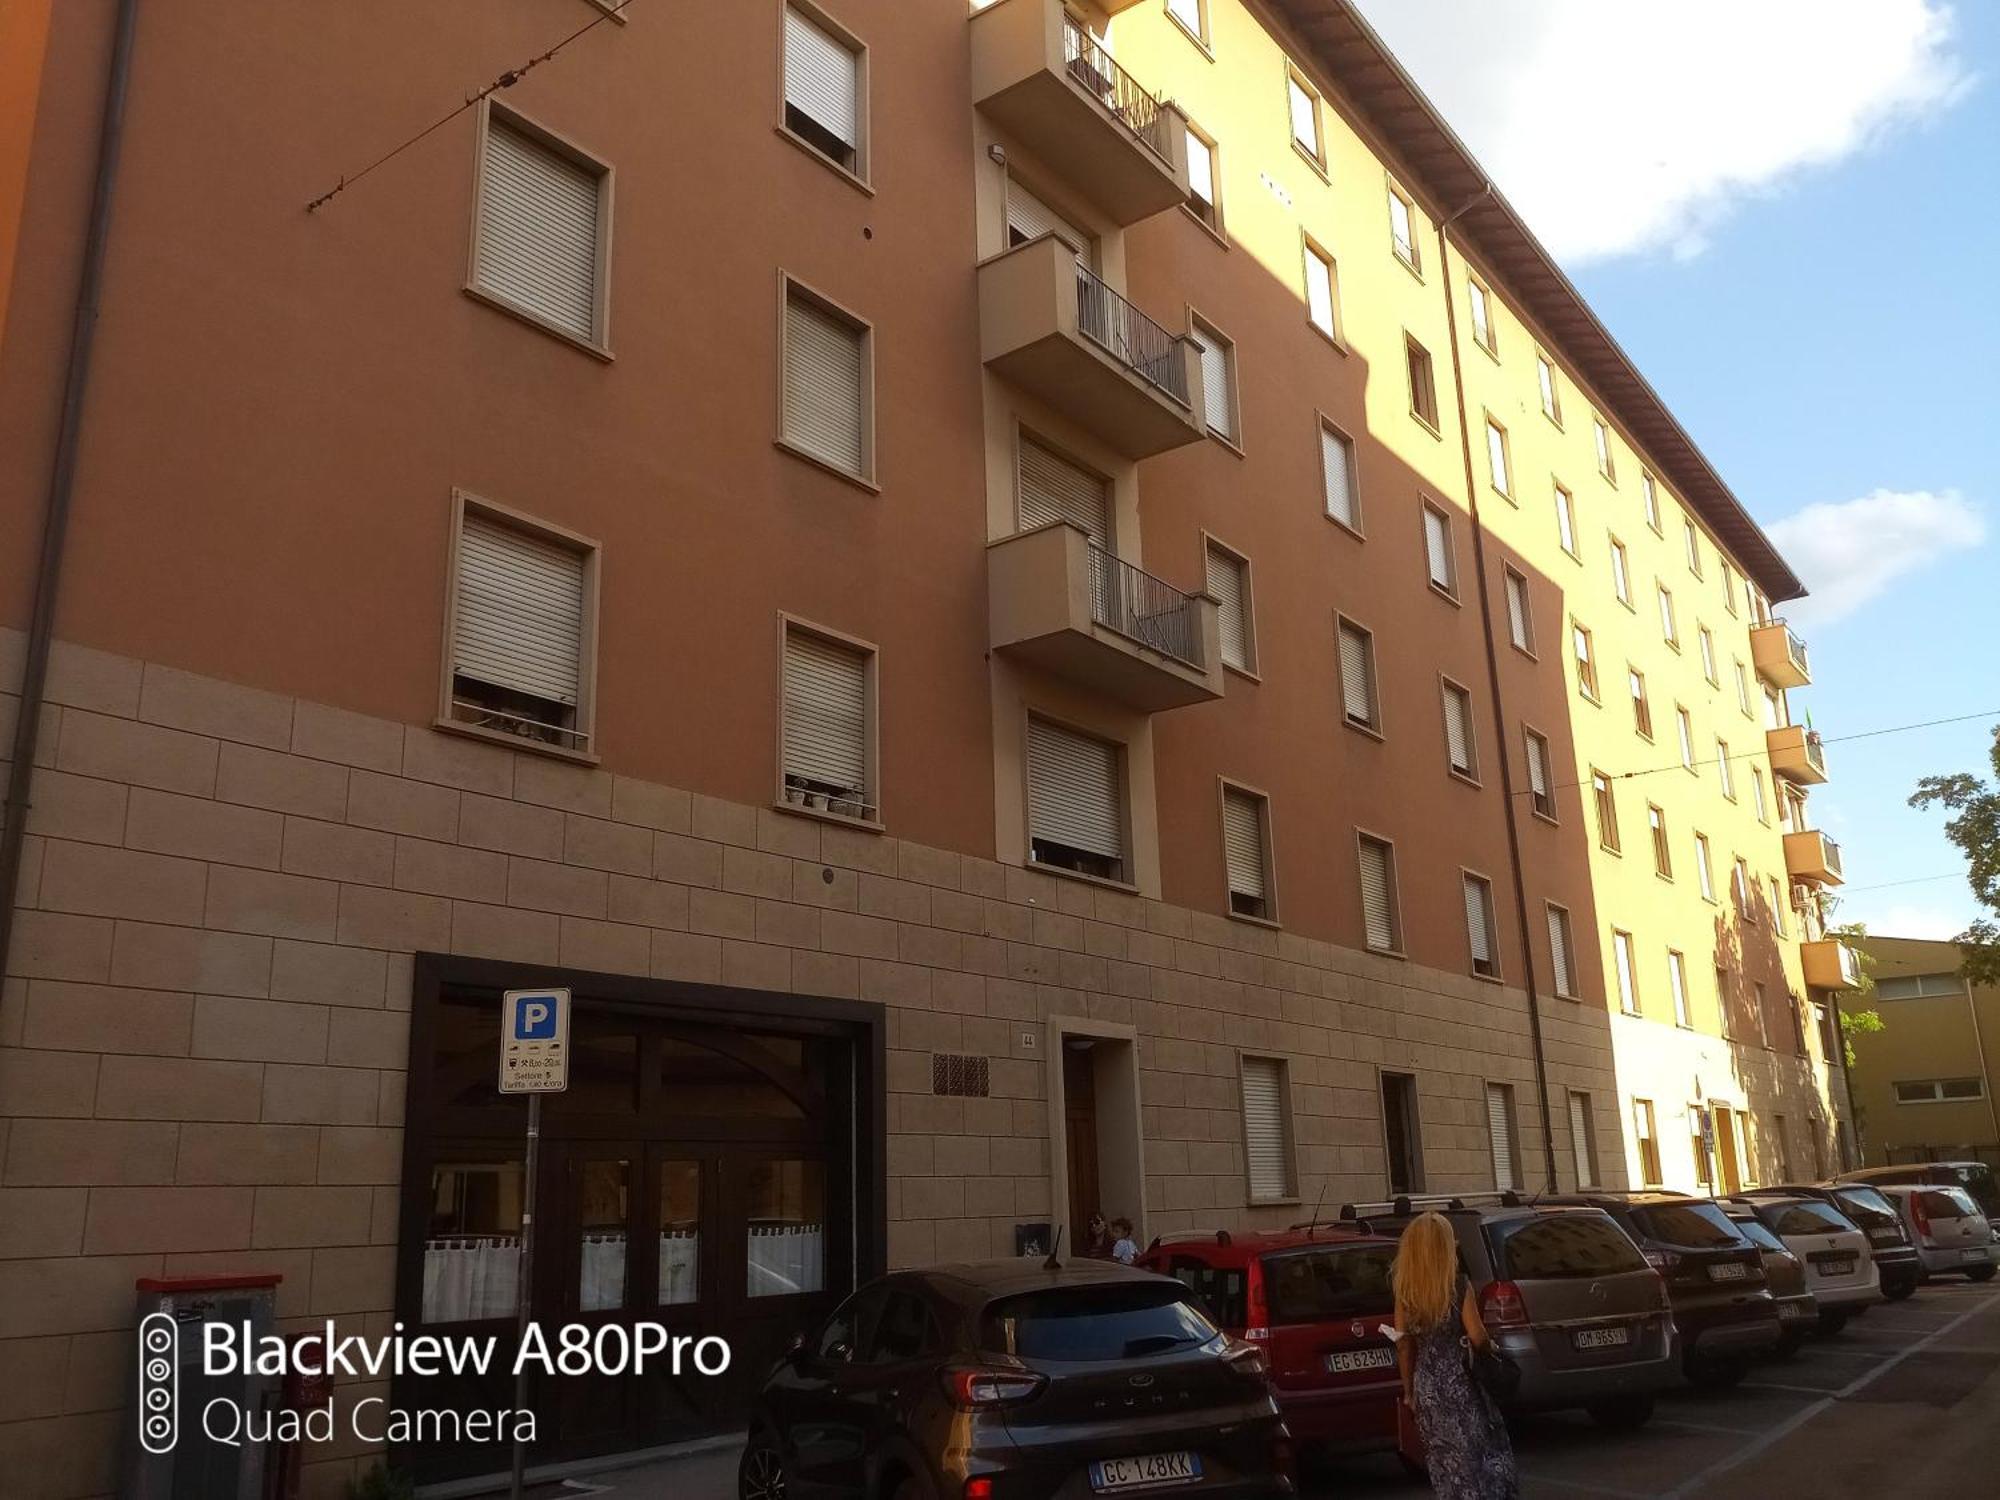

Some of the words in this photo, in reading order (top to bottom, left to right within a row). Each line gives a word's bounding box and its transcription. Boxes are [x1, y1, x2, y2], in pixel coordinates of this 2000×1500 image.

[525, 1004, 548, 1032] P
[1103, 1460, 1127, 1483] GC
[1134, 1454, 1191, 1480] 148KK
